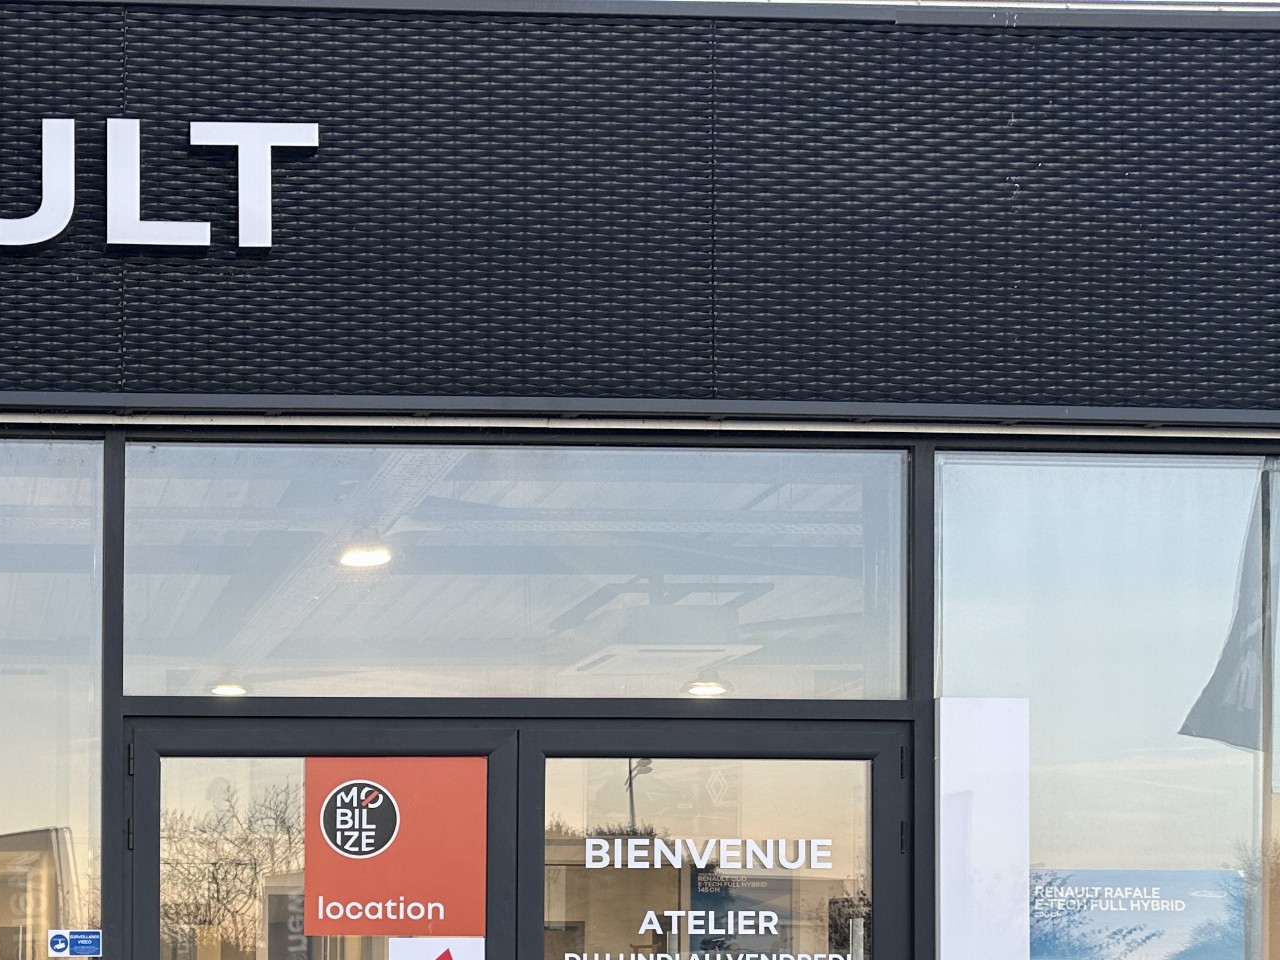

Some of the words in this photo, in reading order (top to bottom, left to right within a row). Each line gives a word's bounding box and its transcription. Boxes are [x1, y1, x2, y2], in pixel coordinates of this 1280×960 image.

[585, 838, 833, 869] BIENVENUE
[1034, 886, 1101, 898] RENAULT
[1104, 887, 1161, 899] RAFALE
[318, 896, 445, 920] location
[1034, 899, 1087, 911] E-TECH
[1090, 899, 1127, 911] FULL
[1130, 900, 1186, 912] HYBRID
[638, 910, 779, 935] ATELIER
